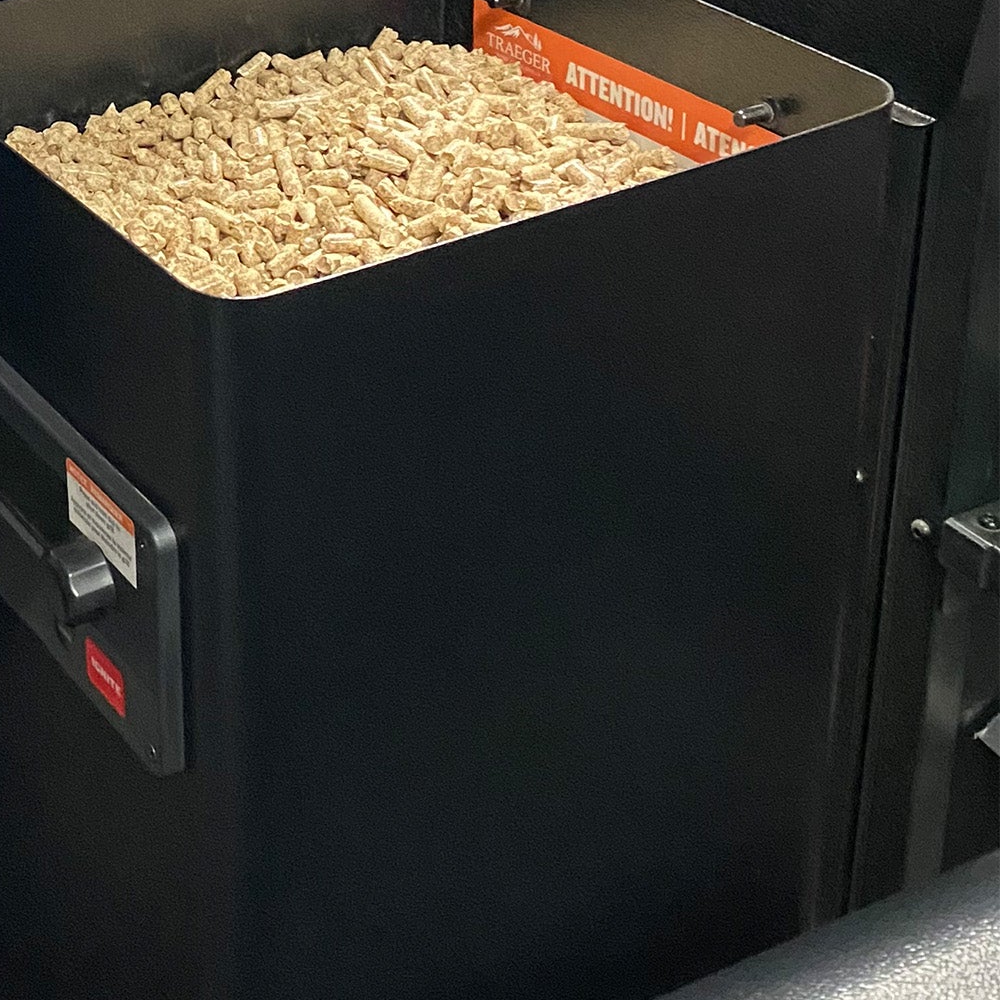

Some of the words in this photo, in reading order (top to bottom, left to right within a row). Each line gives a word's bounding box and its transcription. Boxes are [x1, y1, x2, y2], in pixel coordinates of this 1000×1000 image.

[486, 31, 551, 74] TRAEGER
[565, 61, 674, 132] ATTENTION!
[693, 121, 755, 157] ATEN
